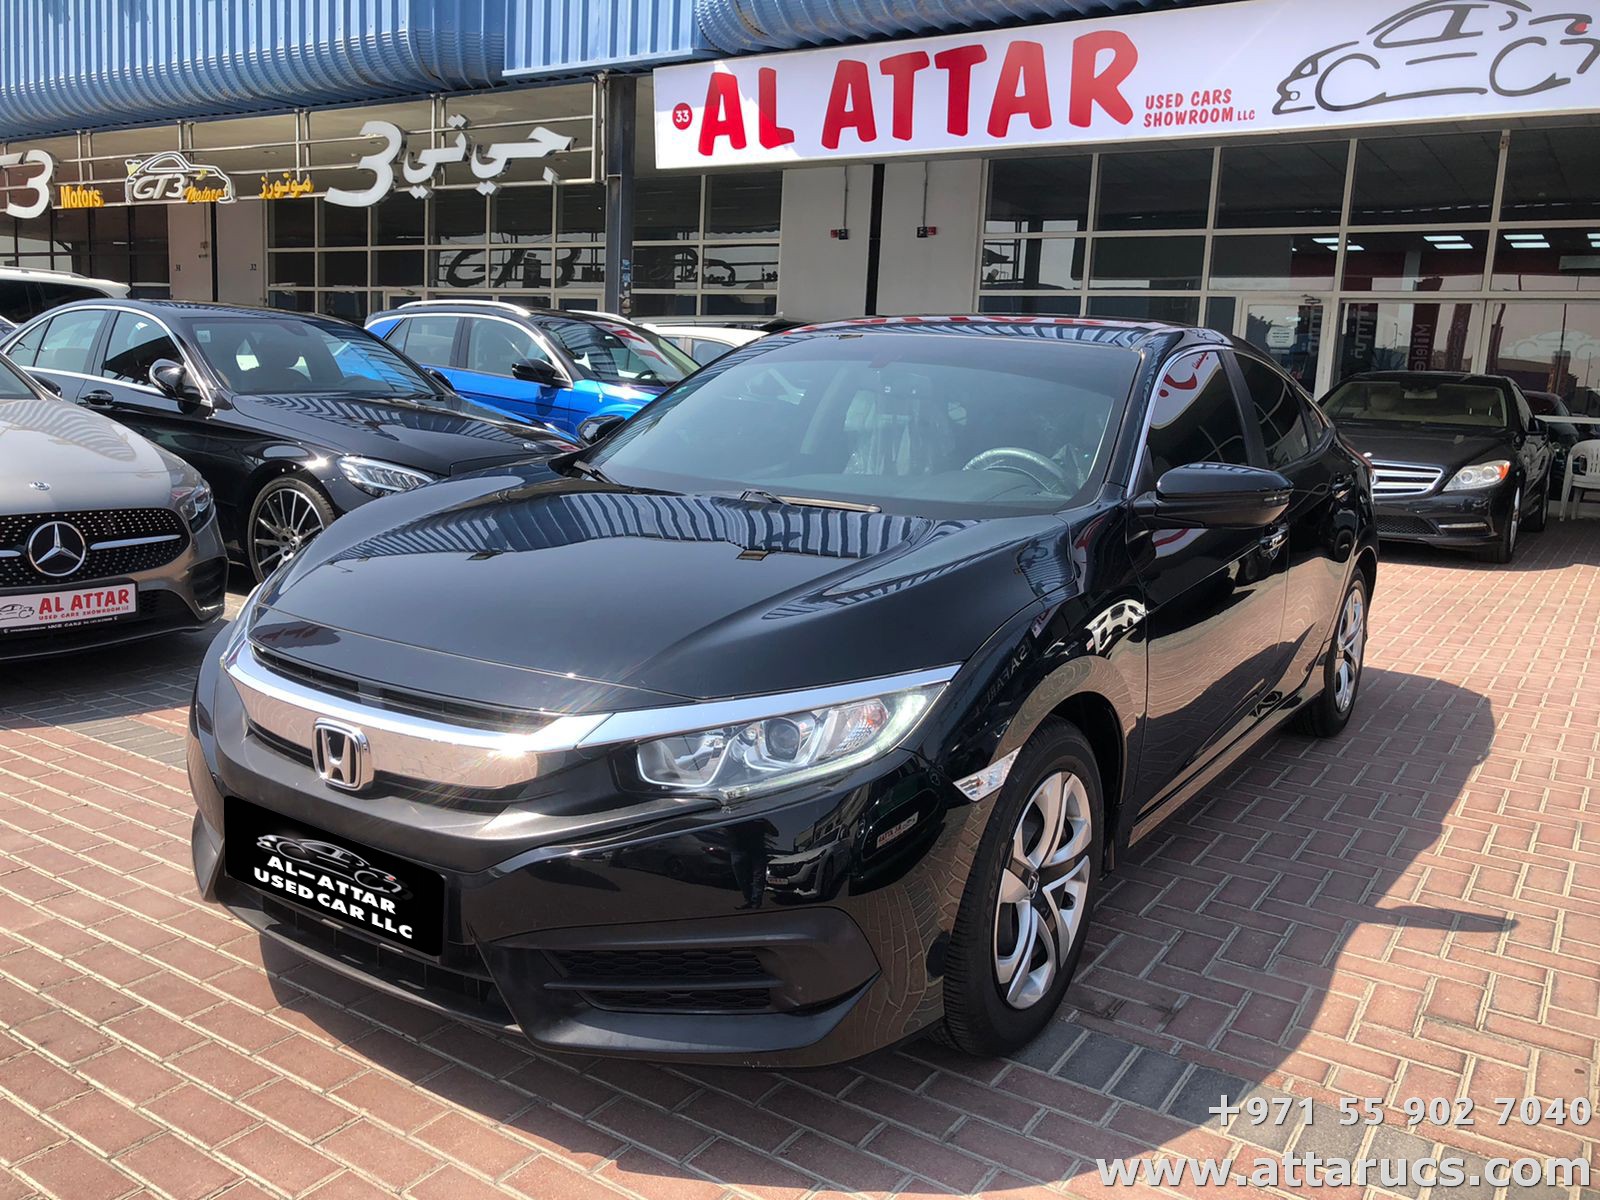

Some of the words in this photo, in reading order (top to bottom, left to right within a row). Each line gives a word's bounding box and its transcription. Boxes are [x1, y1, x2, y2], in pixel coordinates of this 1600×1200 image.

[675, 109, 690, 124] 33
[698, 67, 795, 156] AL
[820, 30, 1139, 150] ATTAR
[1145, 92, 1185, 110] USED
[1190, 88, 1232, 107] CARS
[1143, 106, 1234, 128] SHOWROOM
[1237, 109, 1256, 121] LLC
[324, 120, 403, 207] 3
[60, 184, 104, 208] Motors
[133, 174, 187, 200] GT3
[39, 597, 65, 614] AL
[70, 588, 129, 611] ATTAR
